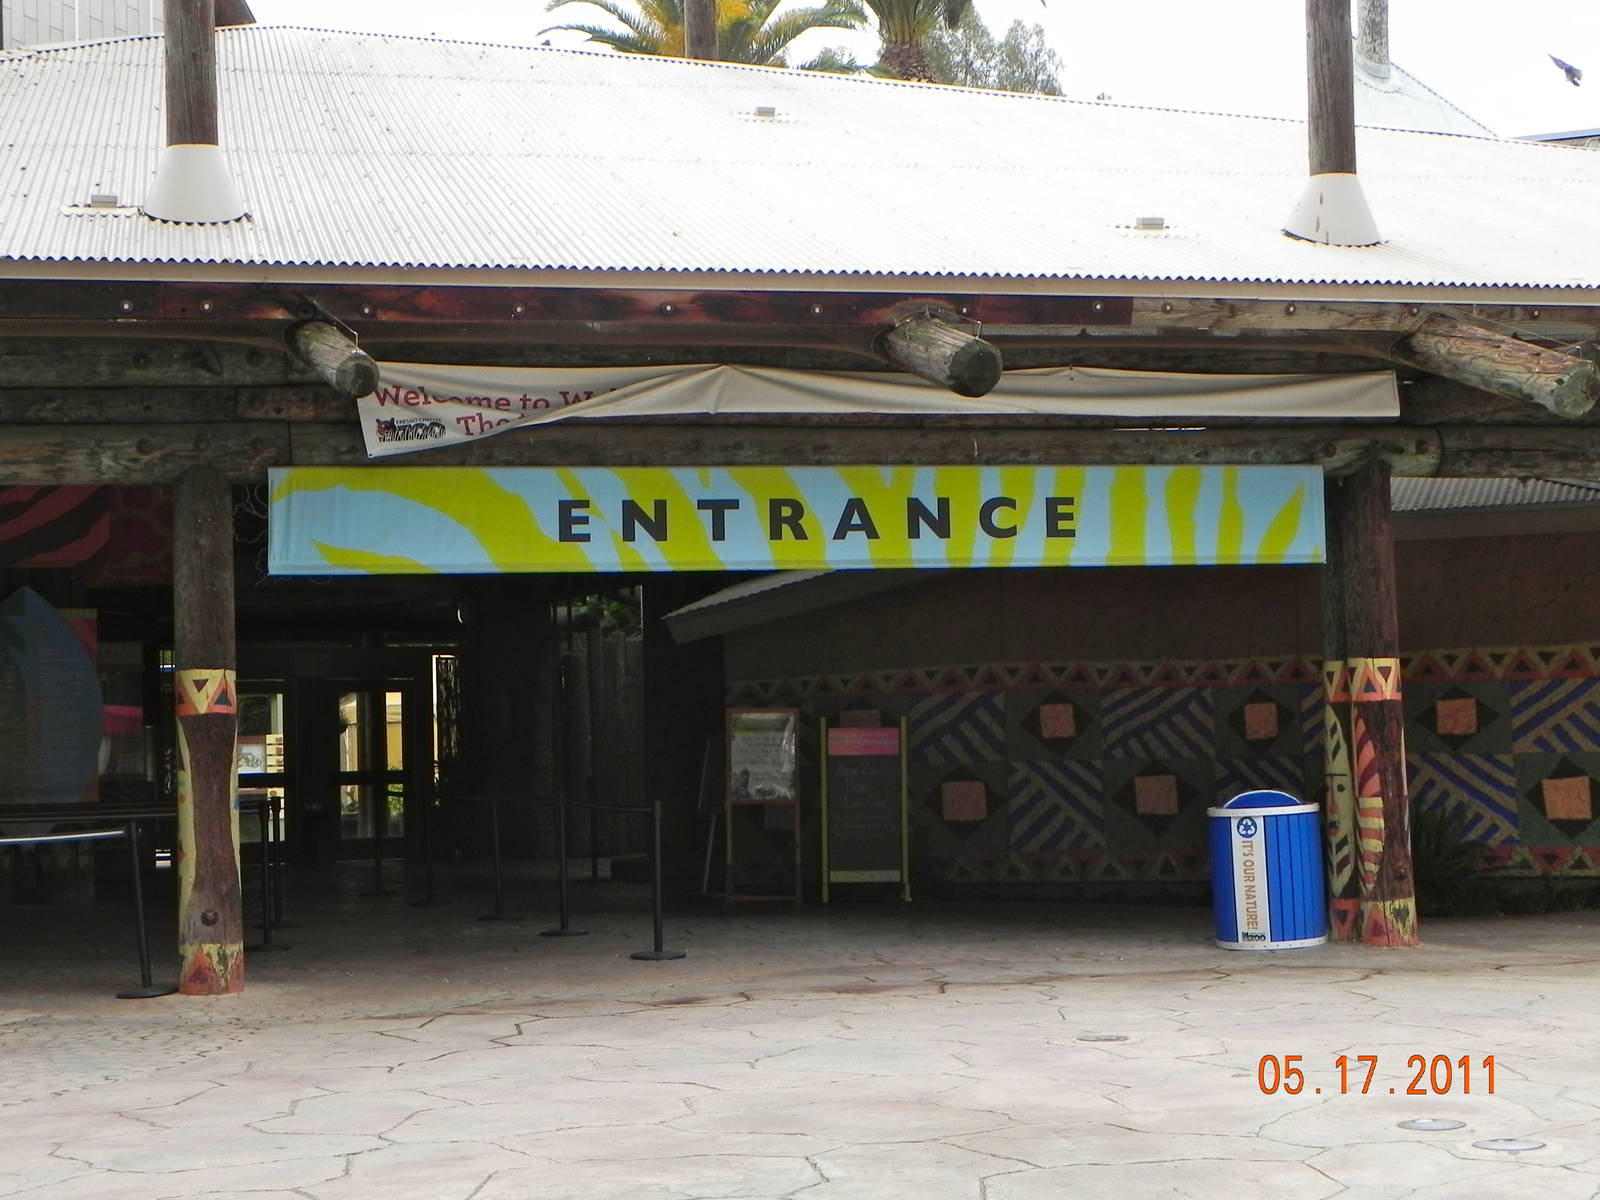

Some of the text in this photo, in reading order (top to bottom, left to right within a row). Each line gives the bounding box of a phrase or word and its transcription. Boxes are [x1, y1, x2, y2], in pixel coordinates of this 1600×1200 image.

[519, 393, 550, 409] to
[557, 496, 1076, 543] ENTRANCE
[1241, 840, 1254, 857] IT'S
[1243, 859, 1256, 882] OUR
[1244, 884, 1258, 930] NATURE!
